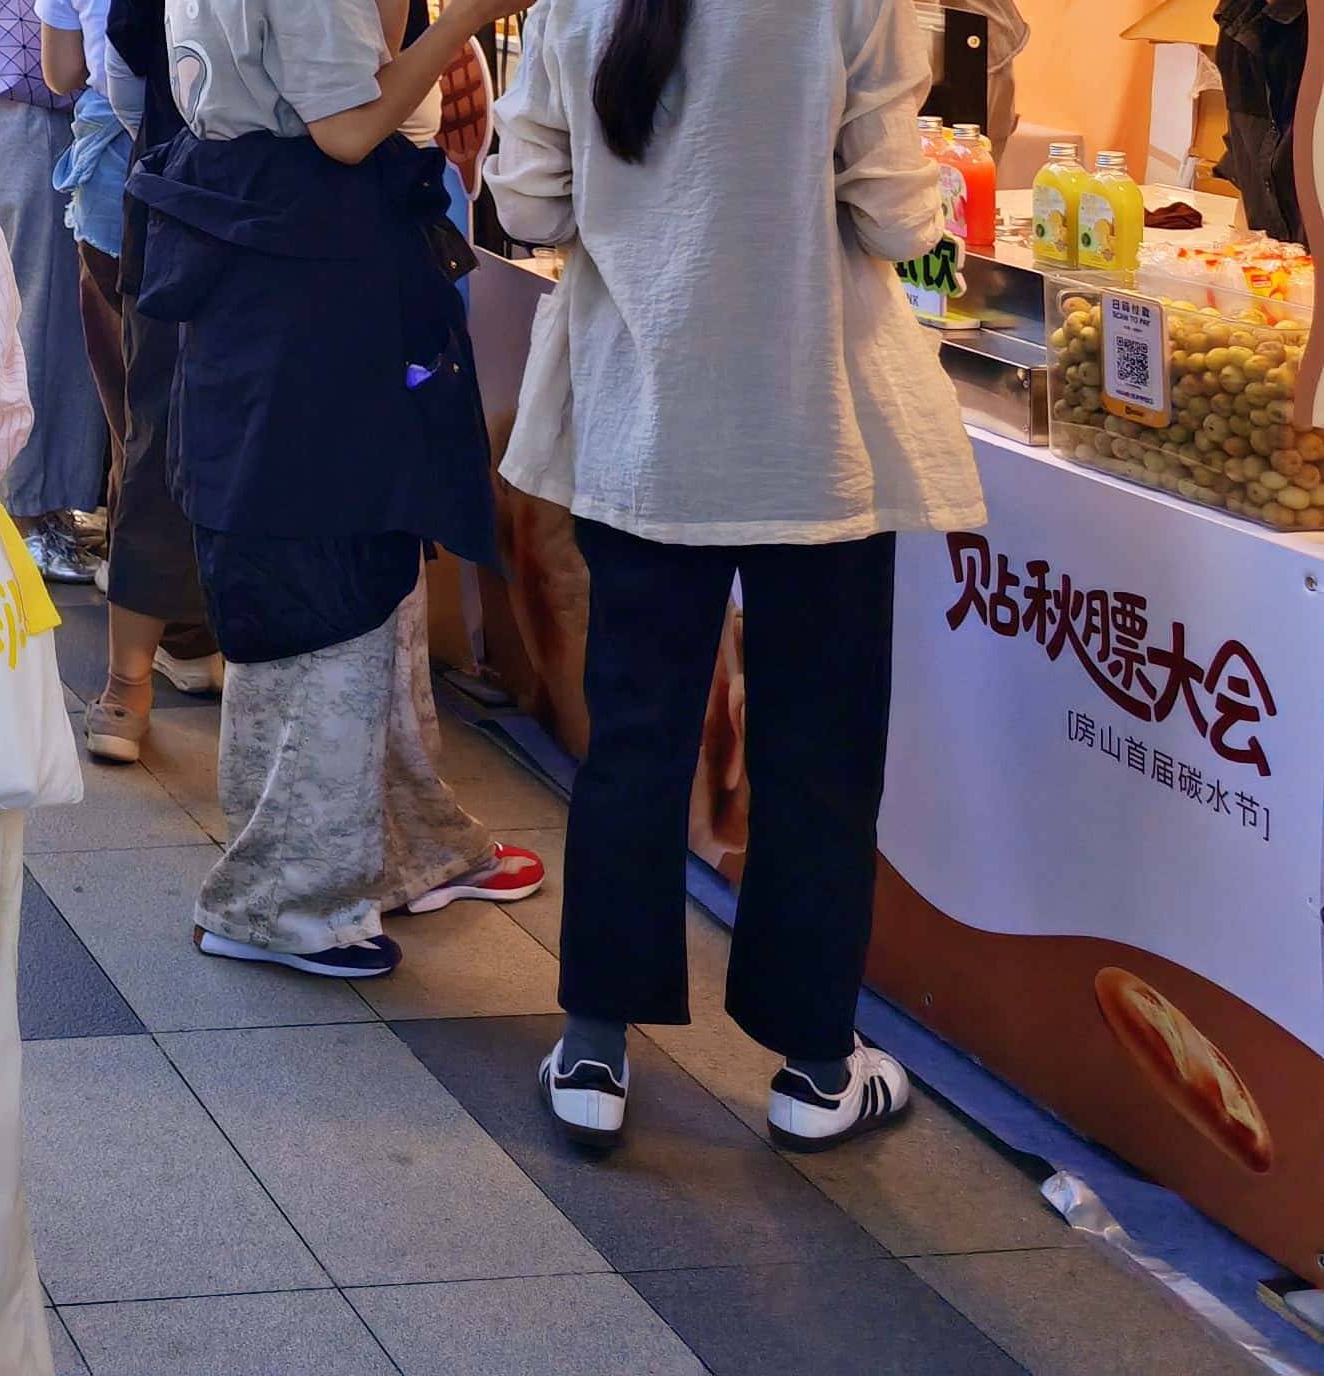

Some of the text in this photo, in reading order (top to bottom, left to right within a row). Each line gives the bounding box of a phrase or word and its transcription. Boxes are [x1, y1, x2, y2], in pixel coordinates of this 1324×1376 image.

[945, 531, 1278, 777] 贴秋膘大会
